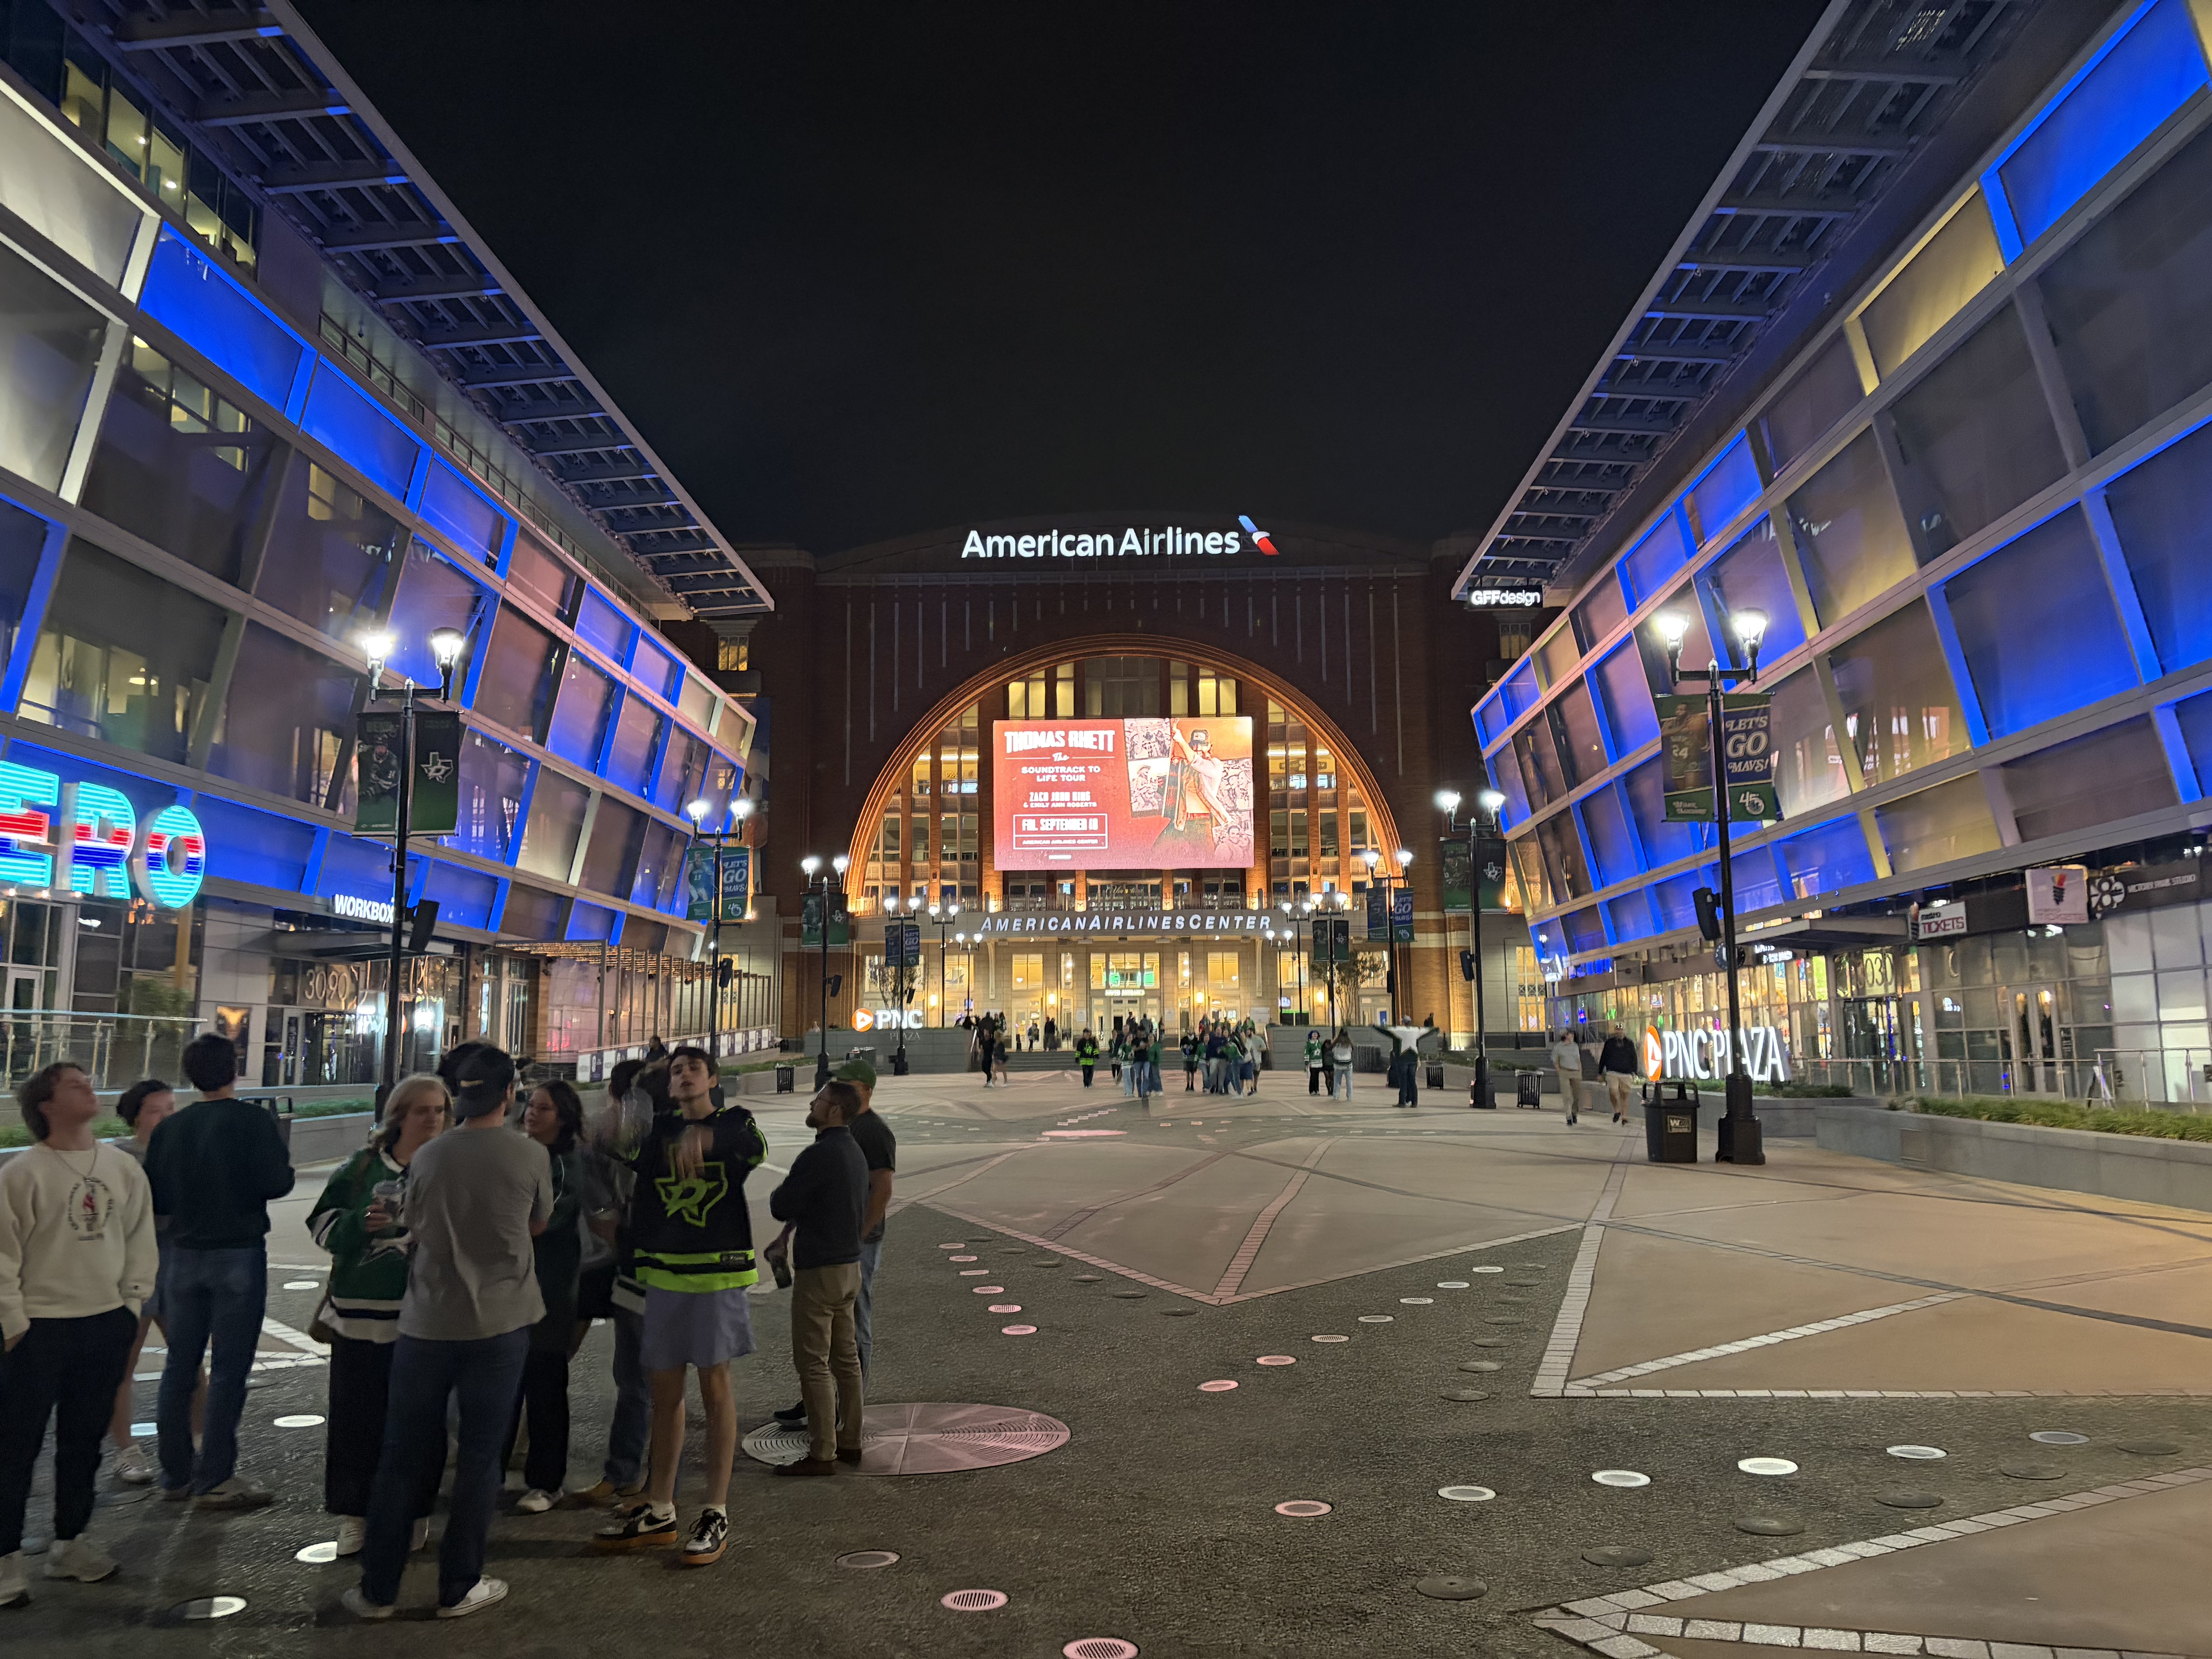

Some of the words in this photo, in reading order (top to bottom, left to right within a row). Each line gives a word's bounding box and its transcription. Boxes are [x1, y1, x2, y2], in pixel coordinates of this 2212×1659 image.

[962, 529, 1113, 558] American
[1118, 527, 1240, 556] Airlines
[1472, 590, 1540, 606] GFFdesign
[1726, 716, 1768, 732] LET'S
[1004, 731, 1065, 753] THOMAS
[1068, 730, 1115, 752] RHETT
[1726, 731, 1768, 758] GO
[1052, 752, 1070, 761] The
[1728, 758, 1769, 773] MAVS!
[1040, 818, 1087, 831] SEPTEMBER
[723, 860, 747, 869] LET'S
[723, 868, 747, 884] GO
[723, 883, 748, 892] MAVS!
[335, 893, 394, 924] WORKBOX
[1395, 902, 1412, 914] GO
[981, 916, 1086, 931] AMERICAN
[1089, 915, 1185, 930] AIRLINES
[1189, 914, 1271, 929] CENTER
[1921, 916, 1965, 934] TICKETS
[305, 969, 348, 1000] 3090
[876, 1009, 923, 1030] PNC
[1663, 1028, 1710, 1080] PNC
